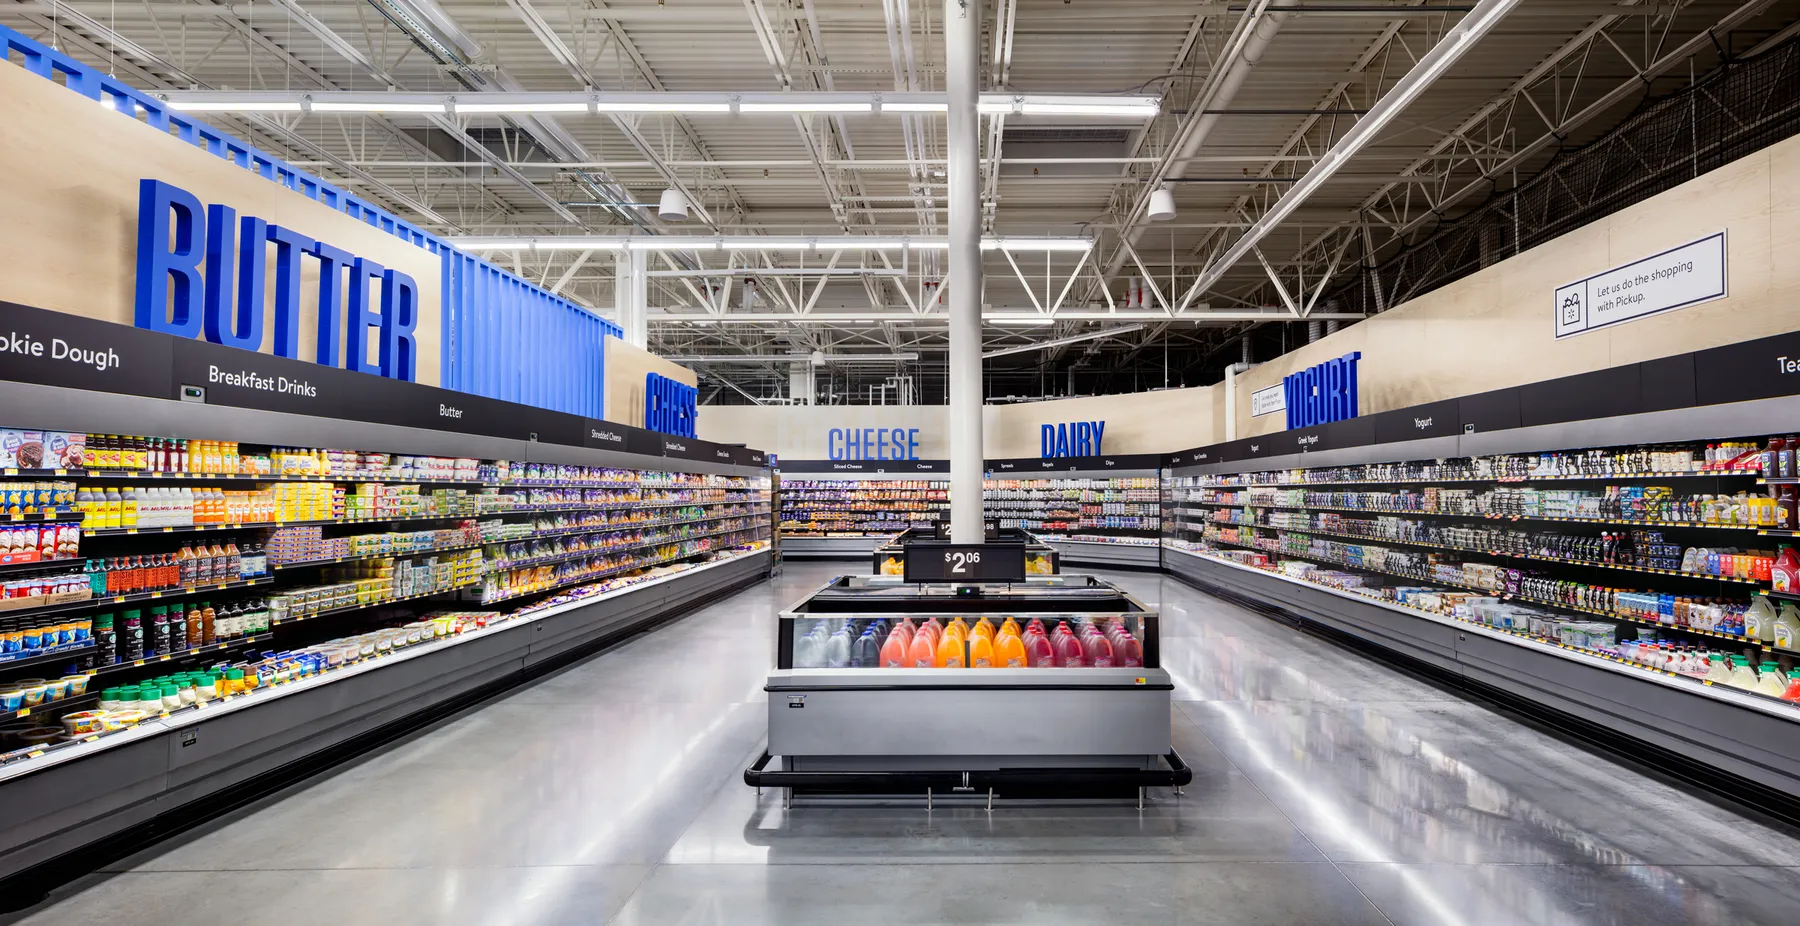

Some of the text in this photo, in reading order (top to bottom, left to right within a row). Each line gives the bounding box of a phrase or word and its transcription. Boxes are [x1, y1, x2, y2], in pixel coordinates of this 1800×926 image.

[134, 179, 419, 383] BUTTER
[1597, 261, 1693, 297] Let us do the shopping
[1597, 293, 1646, 312] with Pickup.
[51, 338, 119, 371] Dough
[209, 365, 316, 397] Breakfast Drinks
[1283, 351, 1361, 431] YOGURT
[439, 403, 463, 419] Butter
[645, 372, 699, 440] CHEESE
[591, 429, 622, 442] Shredded Cheese
[1307, 435, 1319, 444] Yogurt
[1414, 417, 1433, 429] Yogurt
[828, 428, 919, 461] CHEESE
[1041, 421, 1105, 459] DAIRY
